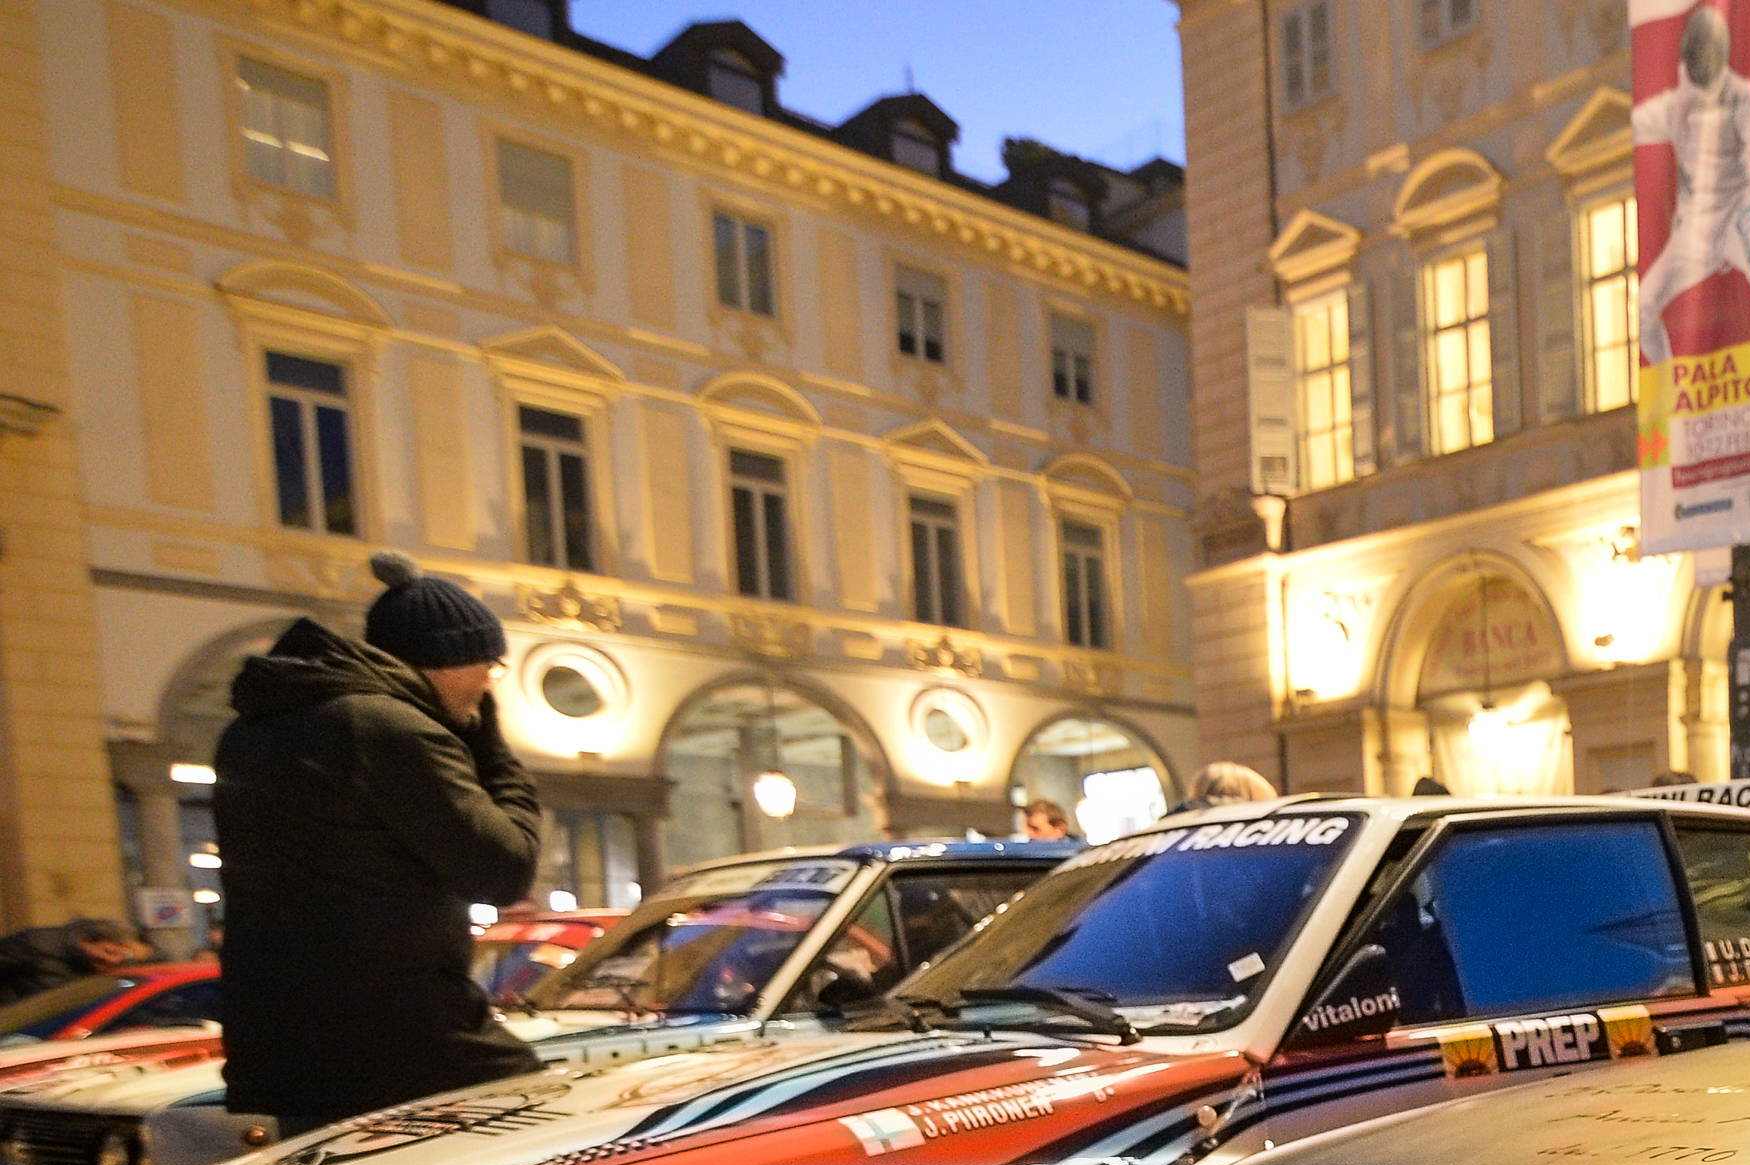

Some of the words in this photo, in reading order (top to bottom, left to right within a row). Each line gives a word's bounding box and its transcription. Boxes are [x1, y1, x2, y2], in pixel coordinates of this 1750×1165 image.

[1673, 354, 1737, 386] PALA
[1179, 816, 1349, 851] RACING
[1302, 986, 1401, 1032] vitaloni
[1495, 1012, 1600, 1069] PREP
[1624, 1145, 1739, 1163] 1770
